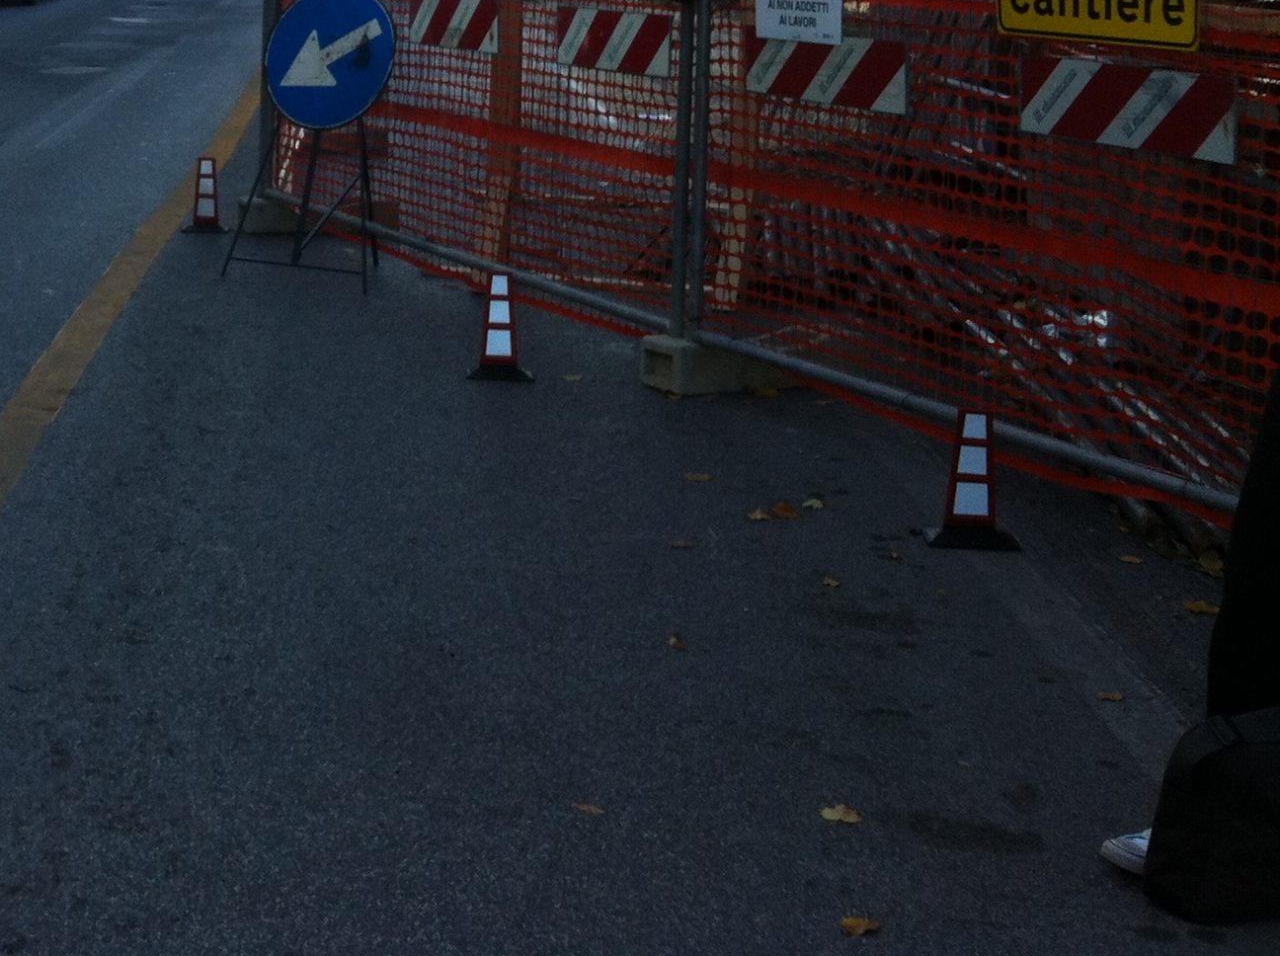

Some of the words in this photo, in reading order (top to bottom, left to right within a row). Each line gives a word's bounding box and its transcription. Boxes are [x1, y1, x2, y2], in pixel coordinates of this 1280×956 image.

[776, 0, 793, 11] NON
[795, 0, 829, 14] ADDETTI
[779, 14, 787, 26] AI
[788, 15, 817, 29] LAVORI
